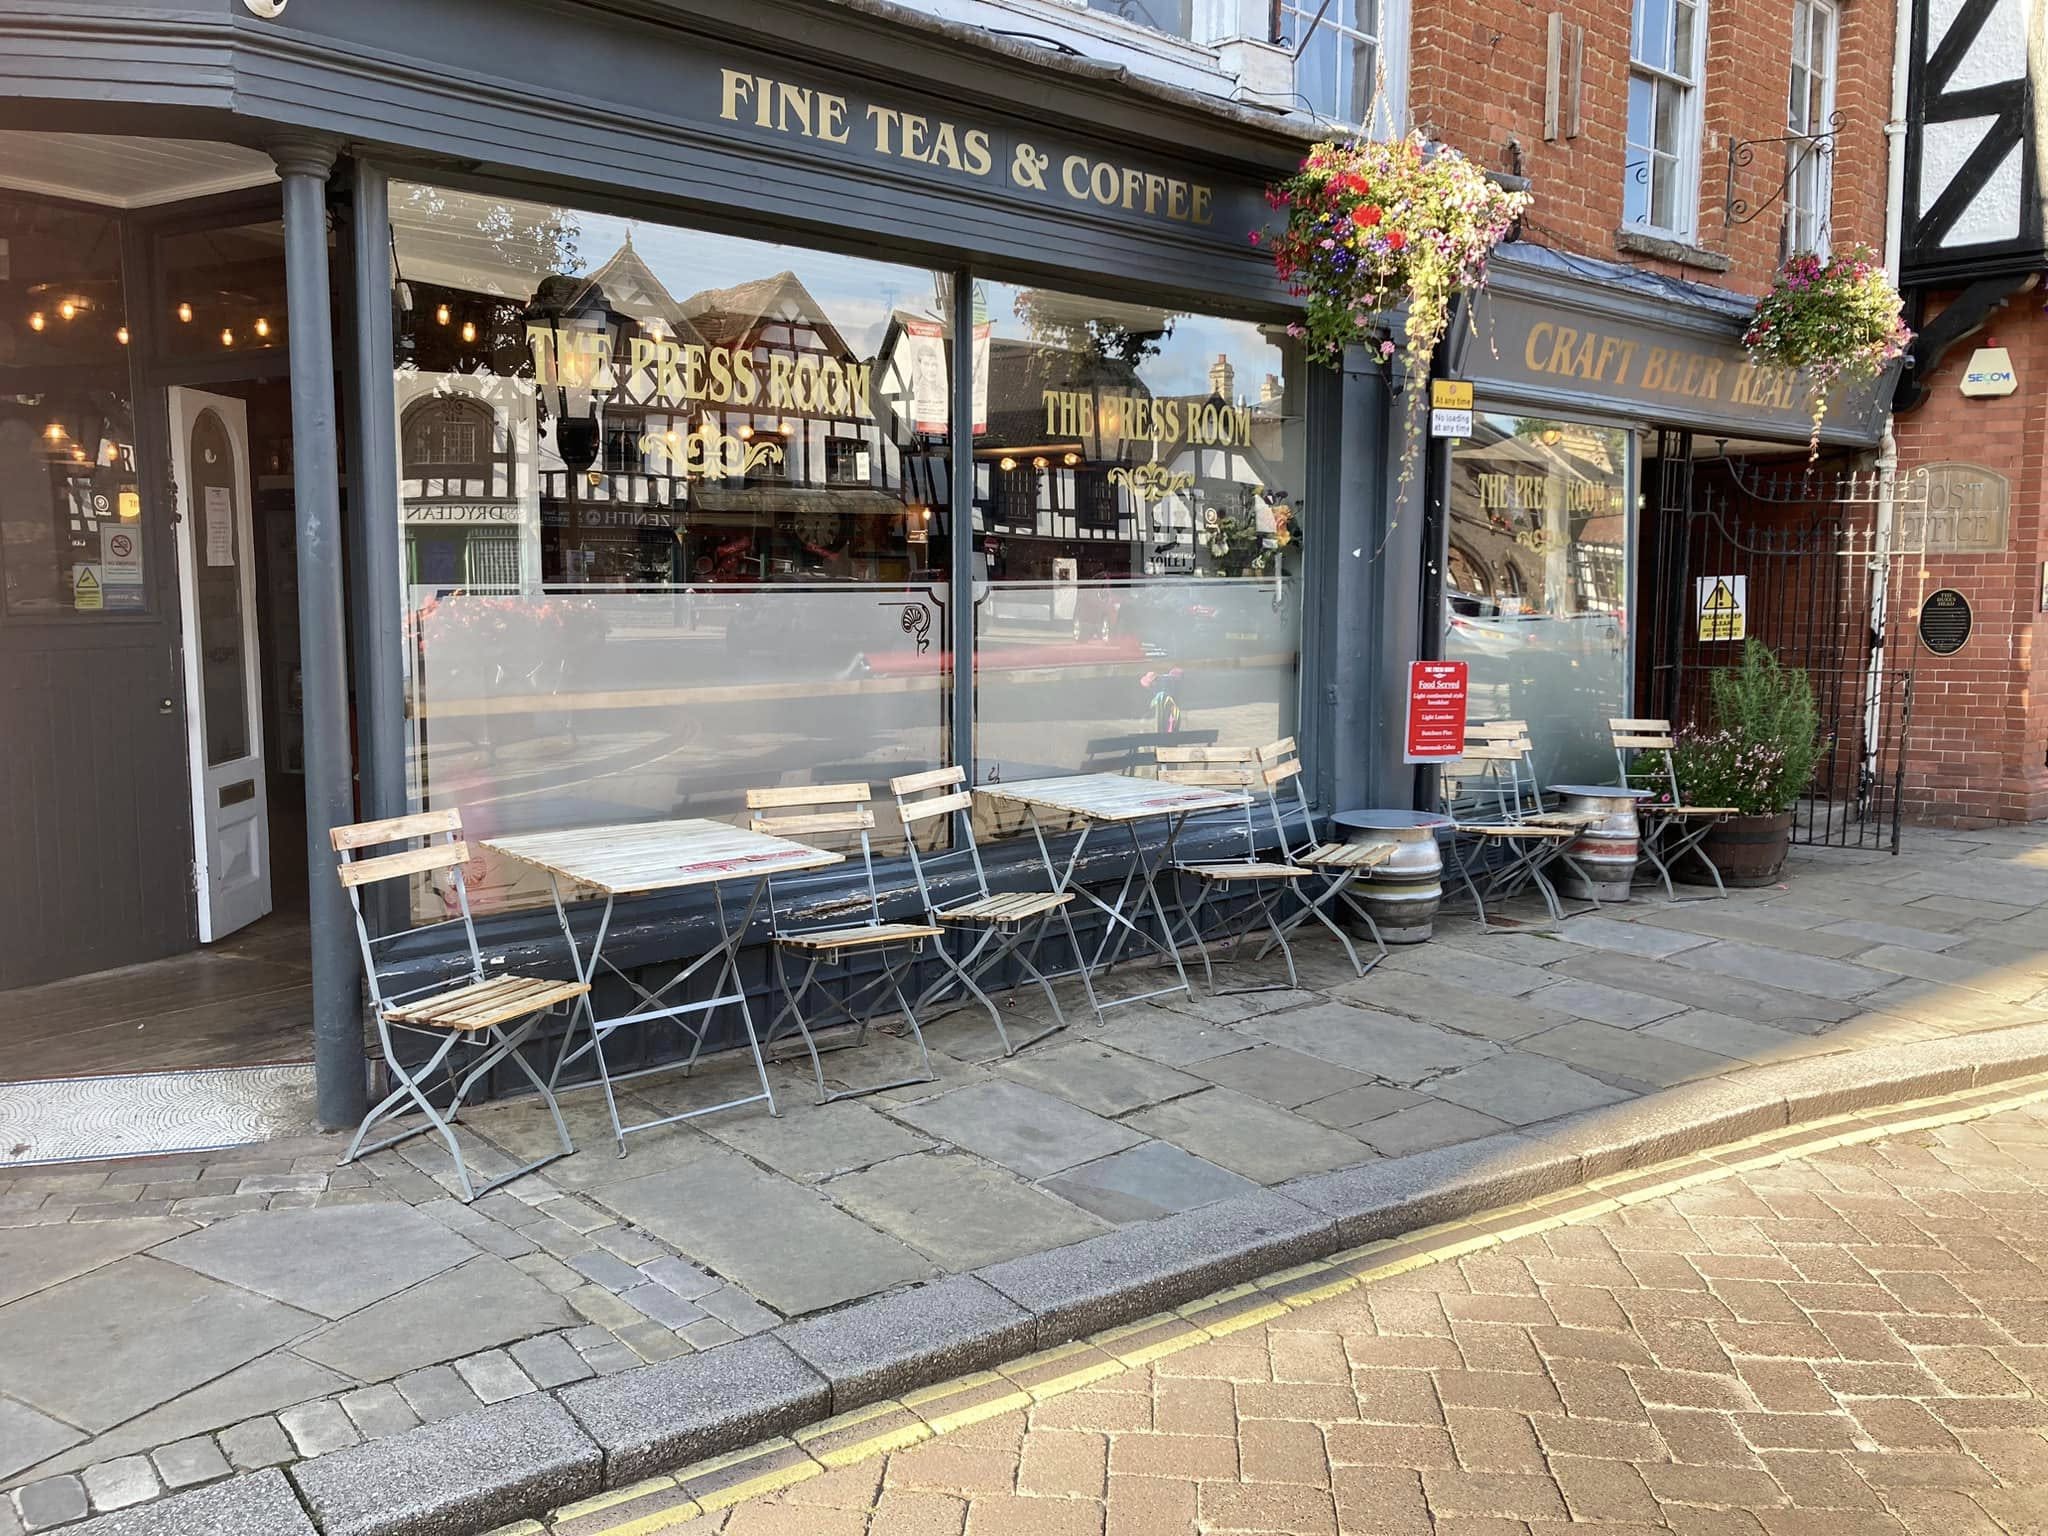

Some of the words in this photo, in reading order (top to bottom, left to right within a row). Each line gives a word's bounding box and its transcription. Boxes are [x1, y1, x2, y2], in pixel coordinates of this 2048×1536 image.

[720, 68, 849, 145] FINE
[866, 104, 992, 176] TEAS
[1011, 143, 1049, 192] &
[1062, 155, 1213, 225] COFFEE
[526, 326, 617, 391] THE
[628, 337, 758, 405] PRESS
[769, 353, 873, 419] ROOM
[1525, 321, 1636, 386] CRAFT
[1639, 348, 1724, 400] BEER
[1731, 361, 1797, 410] REAL
[1968, 372, 2010, 384] SECOM
[1435, 396, 1443, 404] At
[1444, 398, 1456, 407] any
[1457, 398, 1471, 407] time
[1435, 413, 1444, 422] No
[1042, 390, 1094, 437] THE
[1098, 395, 1181, 443] PRESS
[1186, 402, 1251, 447] ROOM
[1478, 474, 1508, 508] THE
[1515, 476, 1559, 509] PRES
[1567, 479, 1605, 512] ROOM
[1913, 483, 1984, 510] POST
[1418, 681, 1436, 689] Food
[1436, 680, 1460, 689] Served
